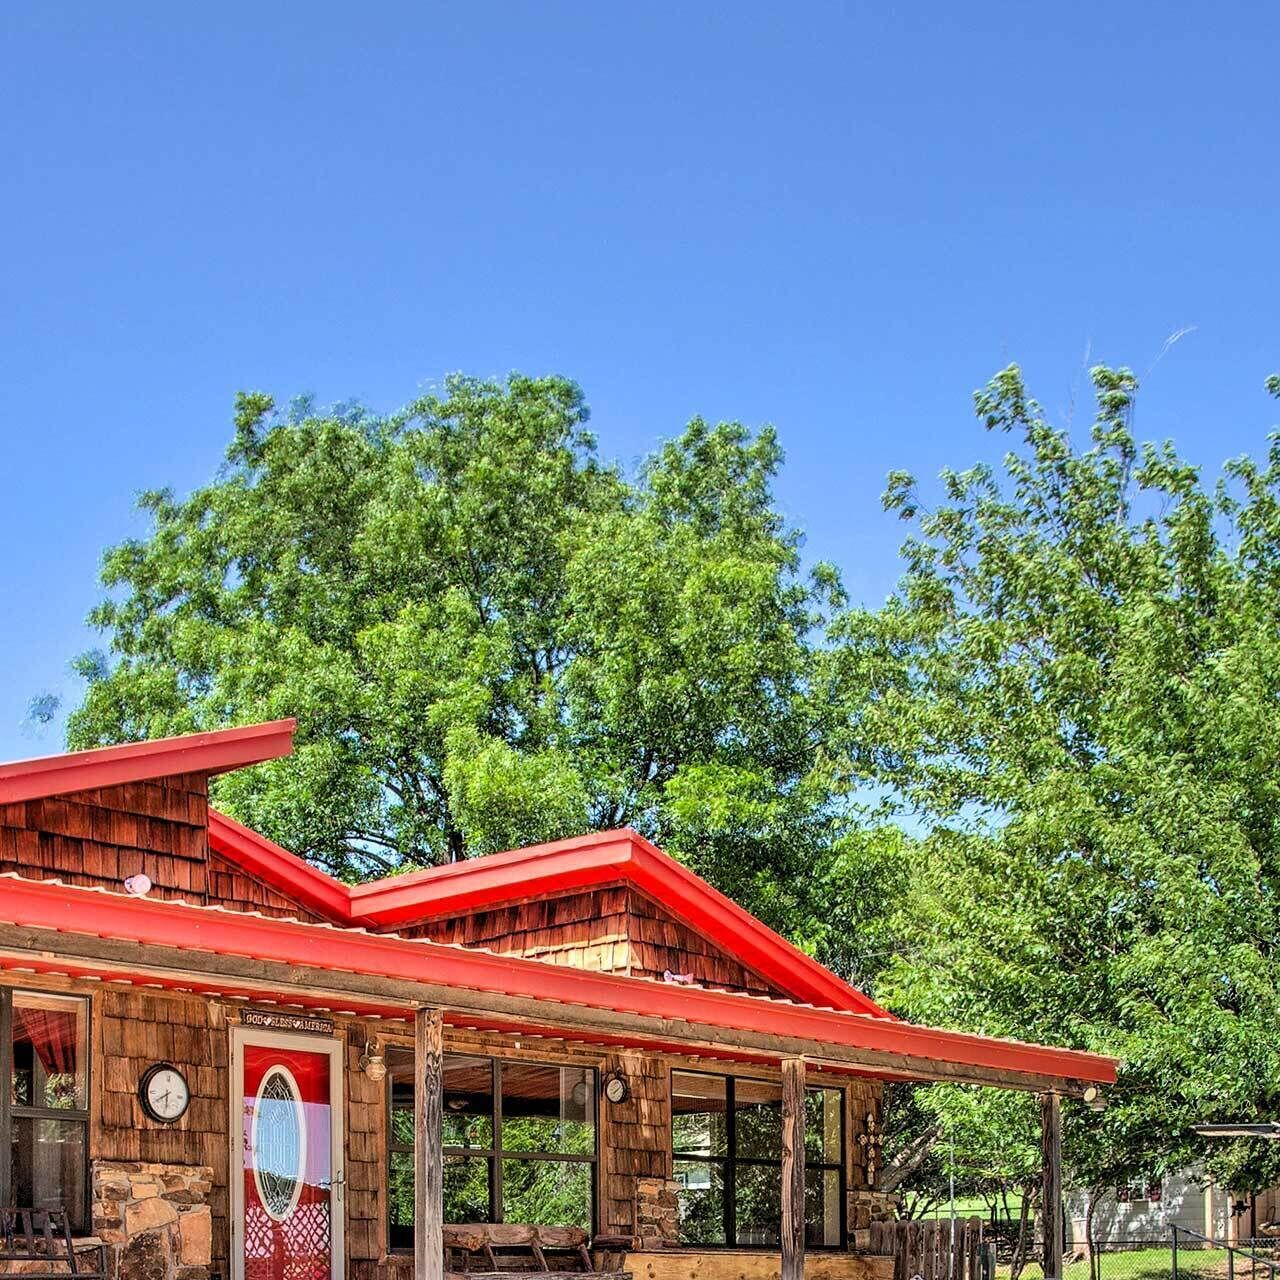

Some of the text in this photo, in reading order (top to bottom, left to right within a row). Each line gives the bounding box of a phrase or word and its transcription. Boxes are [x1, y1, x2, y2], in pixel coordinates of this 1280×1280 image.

[246, 1013, 332, 1033] GOD BLESS AMERICA
